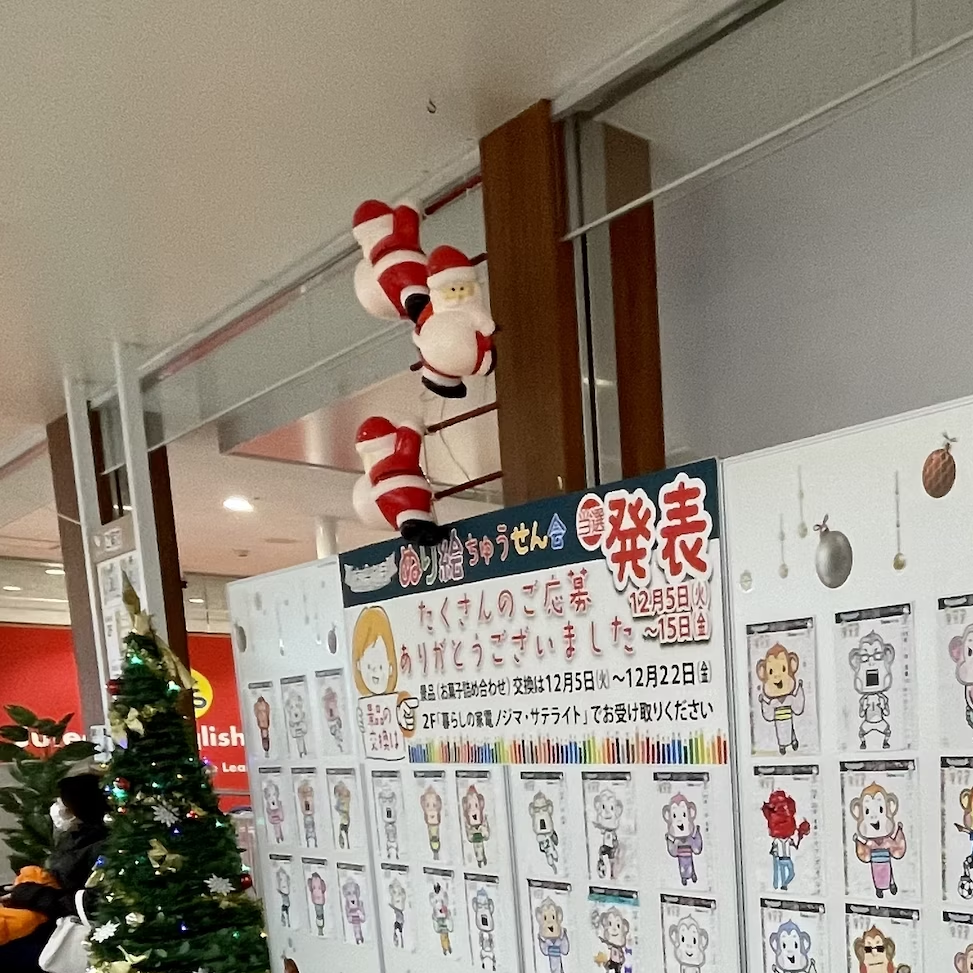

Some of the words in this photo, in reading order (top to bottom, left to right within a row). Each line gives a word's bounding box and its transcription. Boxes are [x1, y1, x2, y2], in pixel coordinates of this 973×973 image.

[604, 481, 708, 583] 発表
[418, 568, 592, 632] たくさんのご応募
[400, 616, 634, 674] ありがとうございました
[198, 724, 245, 750] lish
